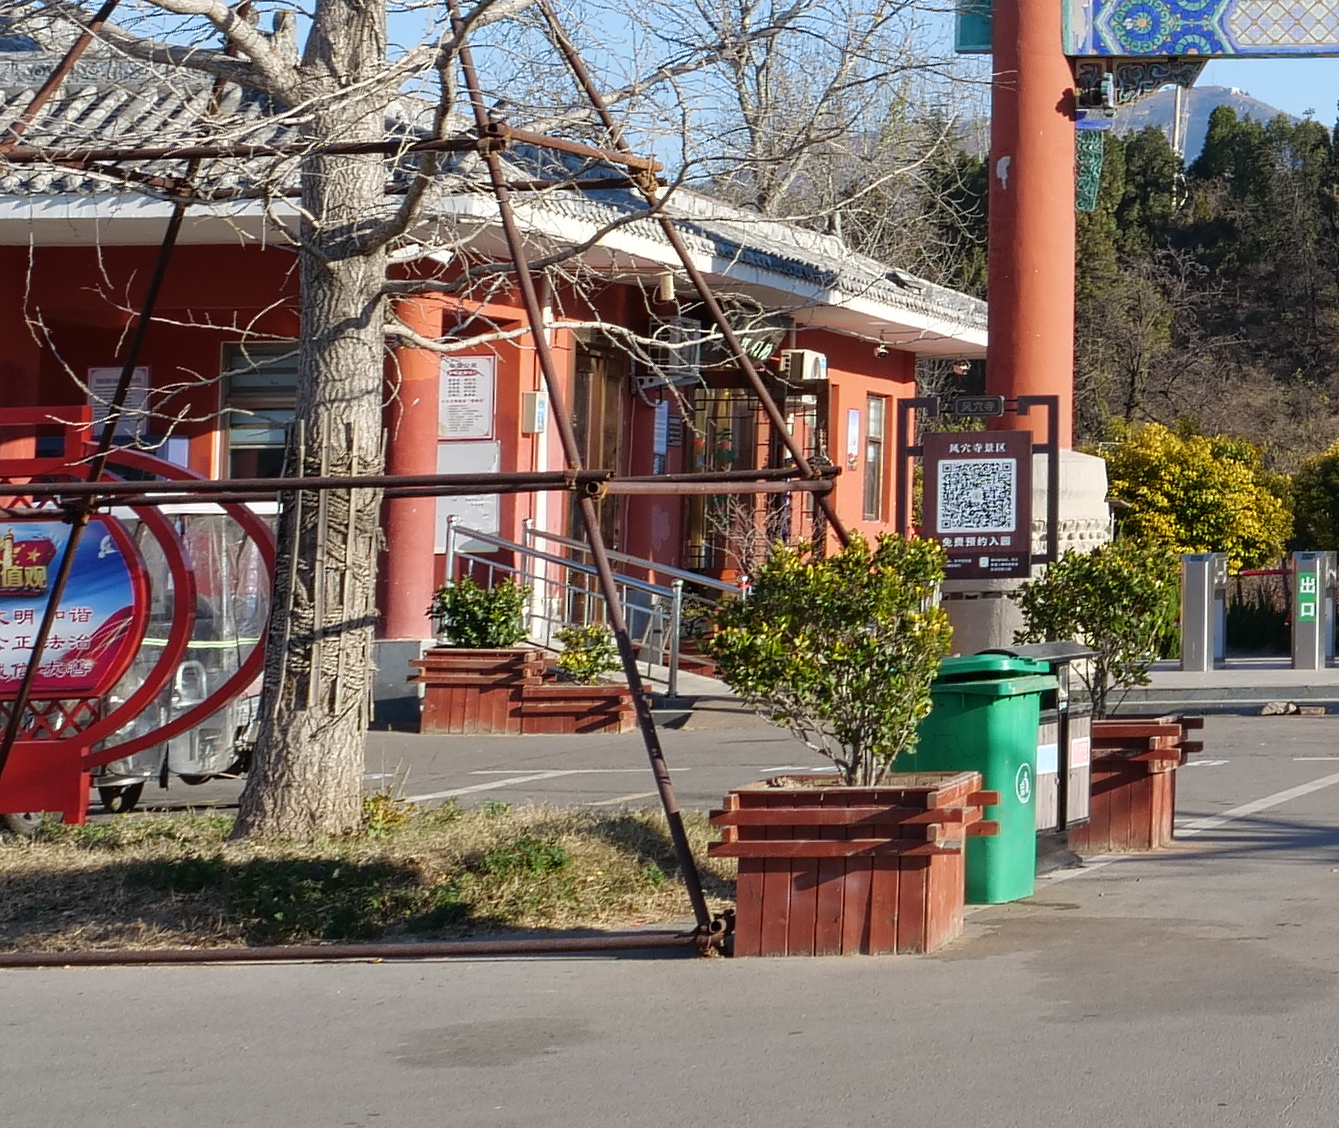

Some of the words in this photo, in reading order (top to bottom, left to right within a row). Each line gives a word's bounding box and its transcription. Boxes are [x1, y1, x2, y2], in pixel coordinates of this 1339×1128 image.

[942, 536, 1012, 548] 免费预约入园
[1300, 576, 1316, 617] 出口
[43, 635, 92, 651] 法治
